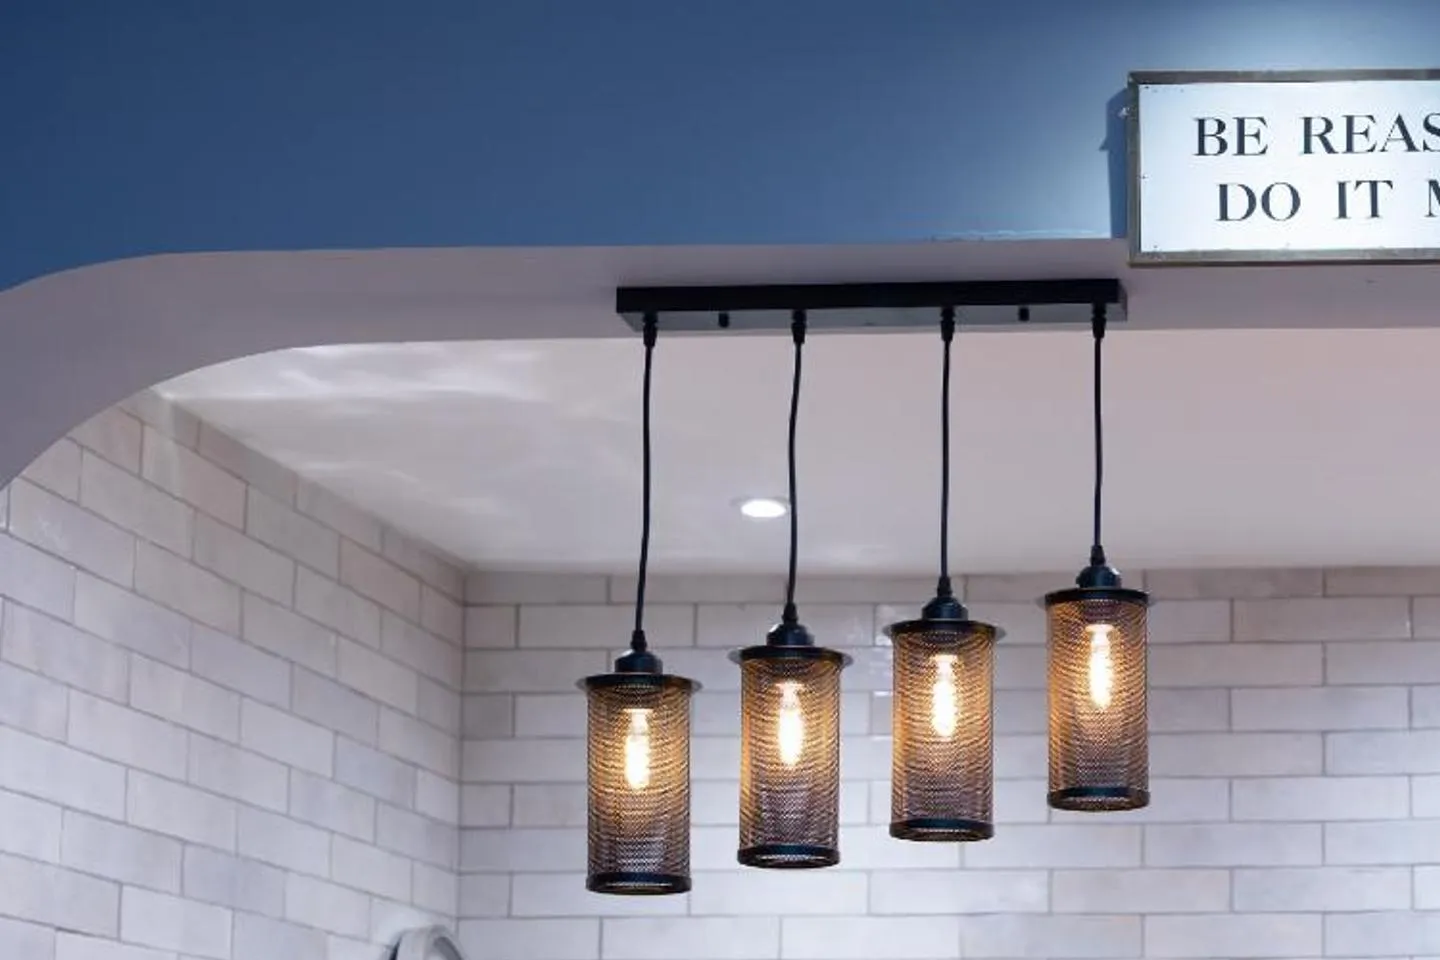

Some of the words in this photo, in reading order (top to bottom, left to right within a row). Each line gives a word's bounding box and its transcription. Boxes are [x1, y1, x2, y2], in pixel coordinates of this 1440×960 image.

[1194, 115, 1268, 157] BE
[1217, 180, 1301, 223] DO
[1333, 178, 1393, 220] IT
